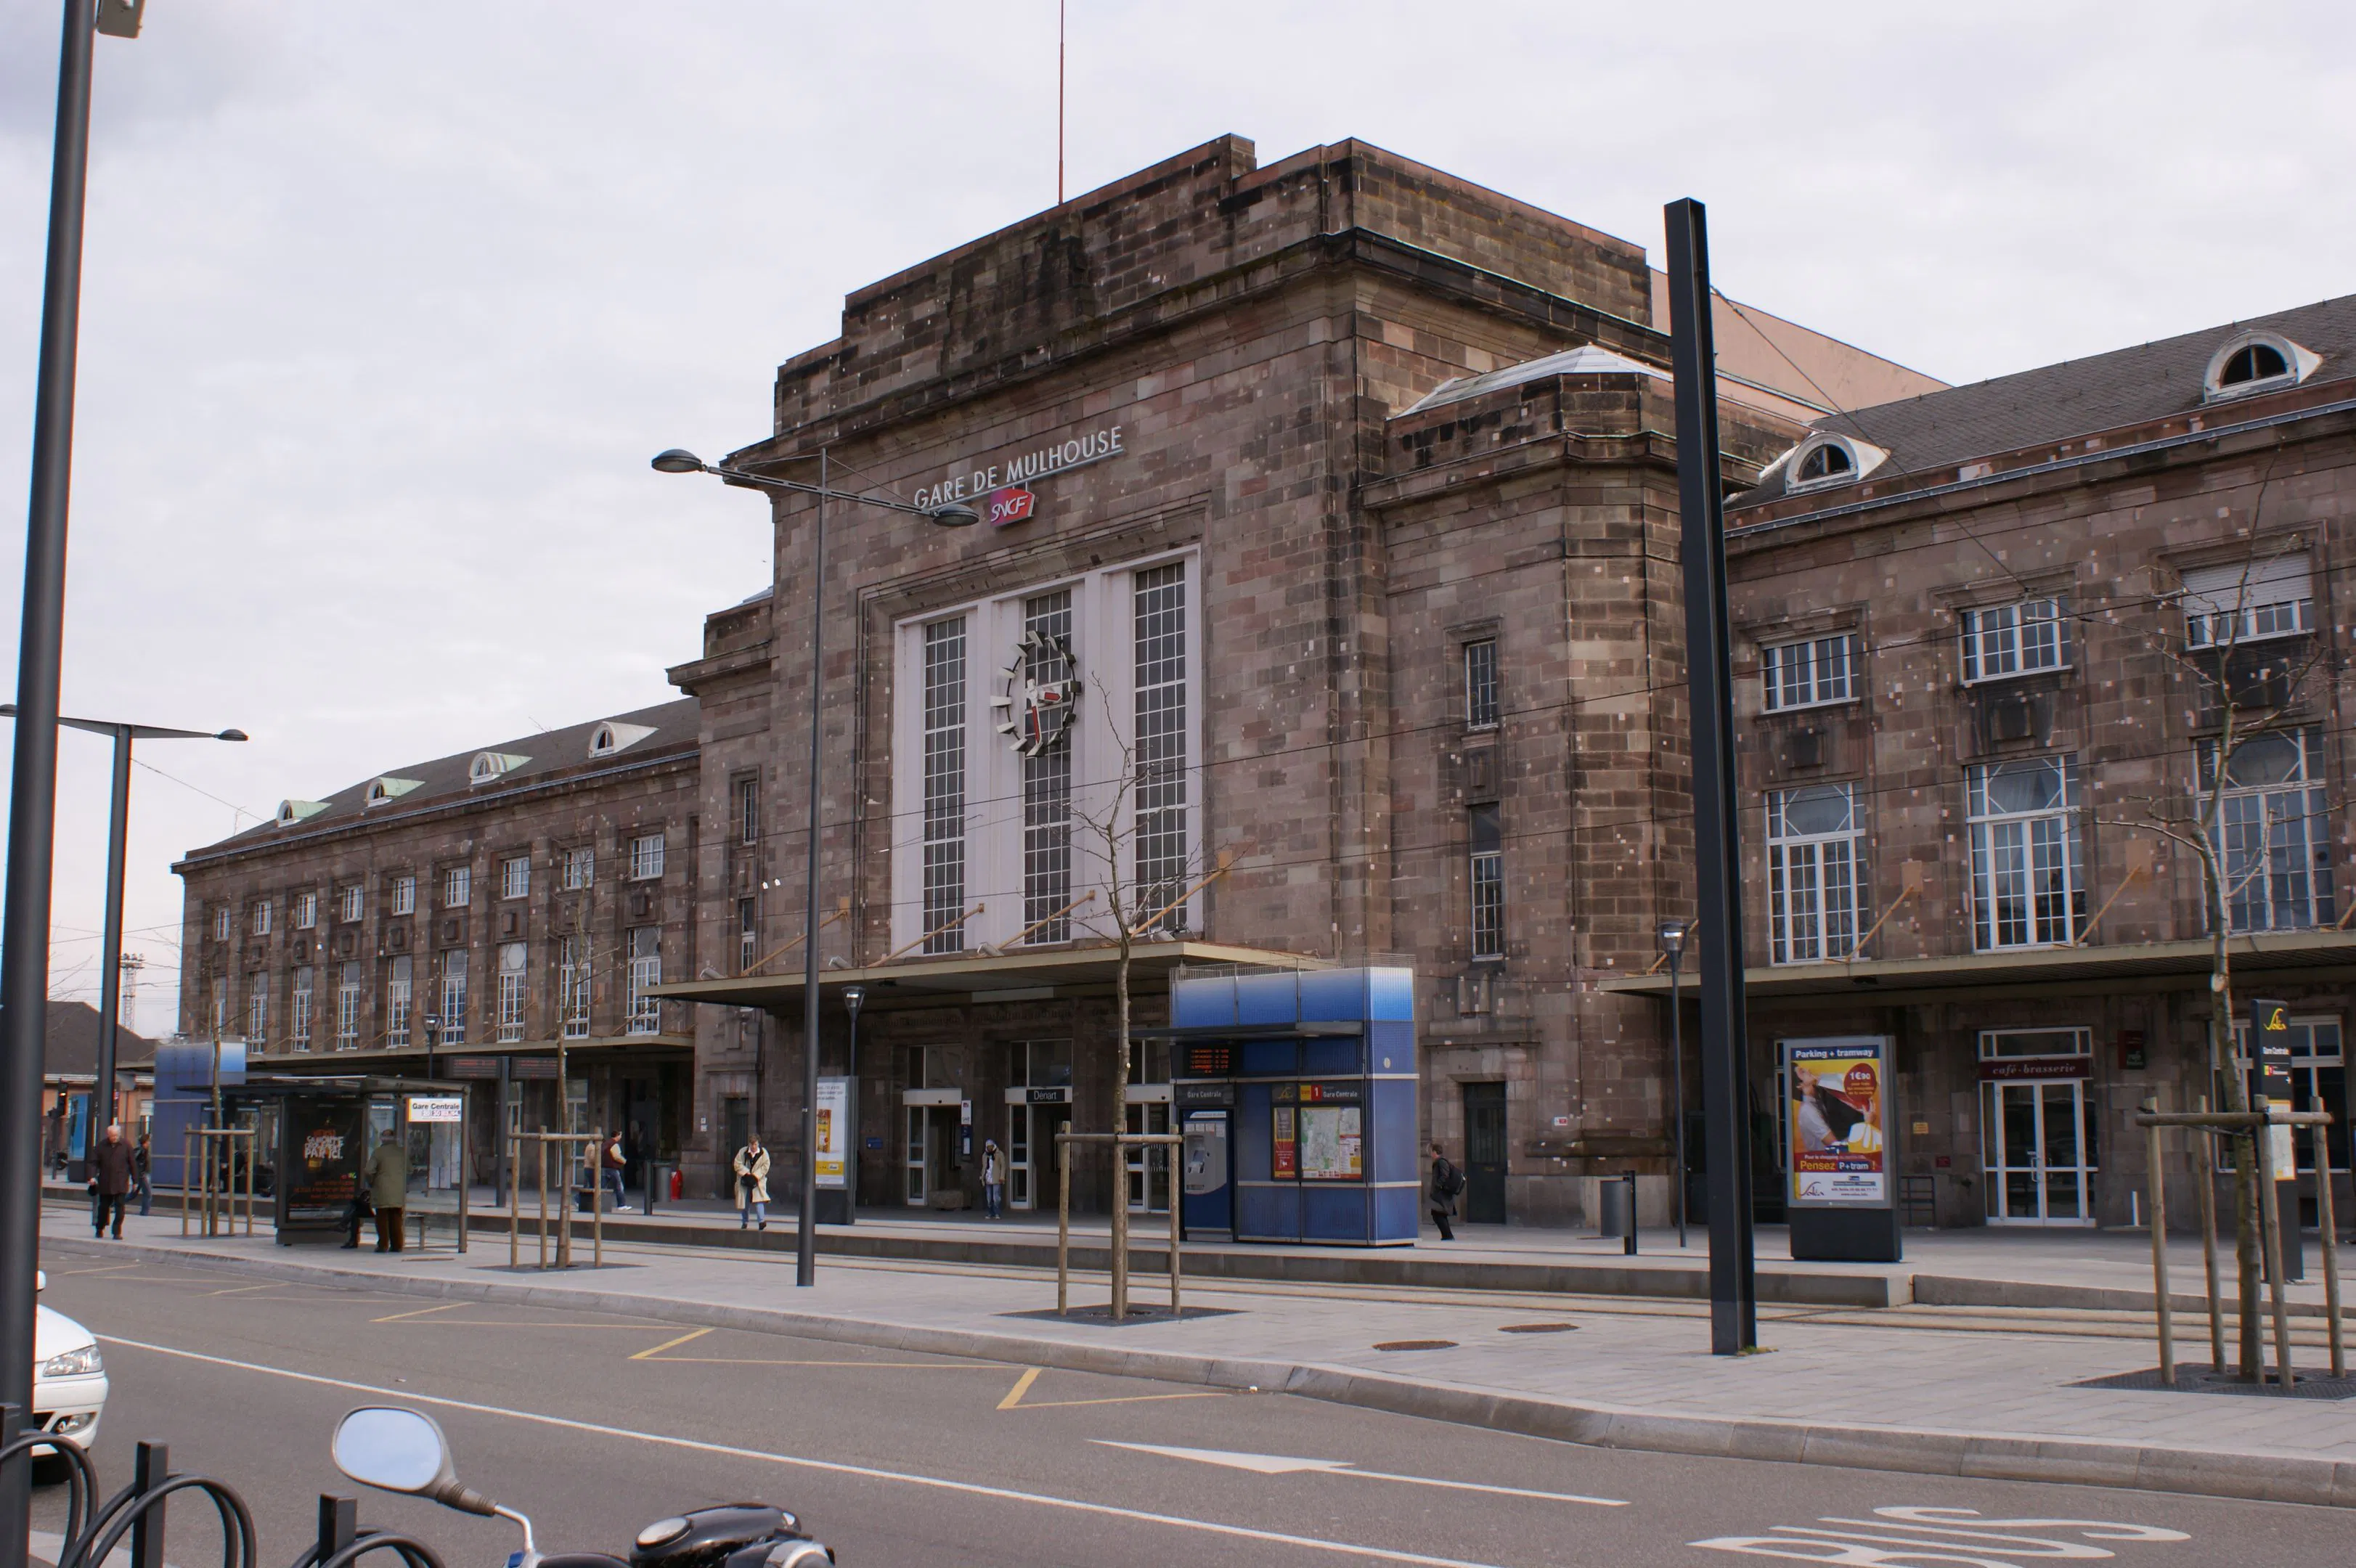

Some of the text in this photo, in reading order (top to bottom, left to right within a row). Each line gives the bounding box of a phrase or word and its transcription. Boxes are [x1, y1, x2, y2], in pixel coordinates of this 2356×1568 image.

[914, 425, 1122, 509] GARE DE MULHOUSE
[990, 495, 1028, 522] SNCF
[1795, 1050, 1828, 1058] Parking
[1801, 1160, 1835, 1170] Pensez
